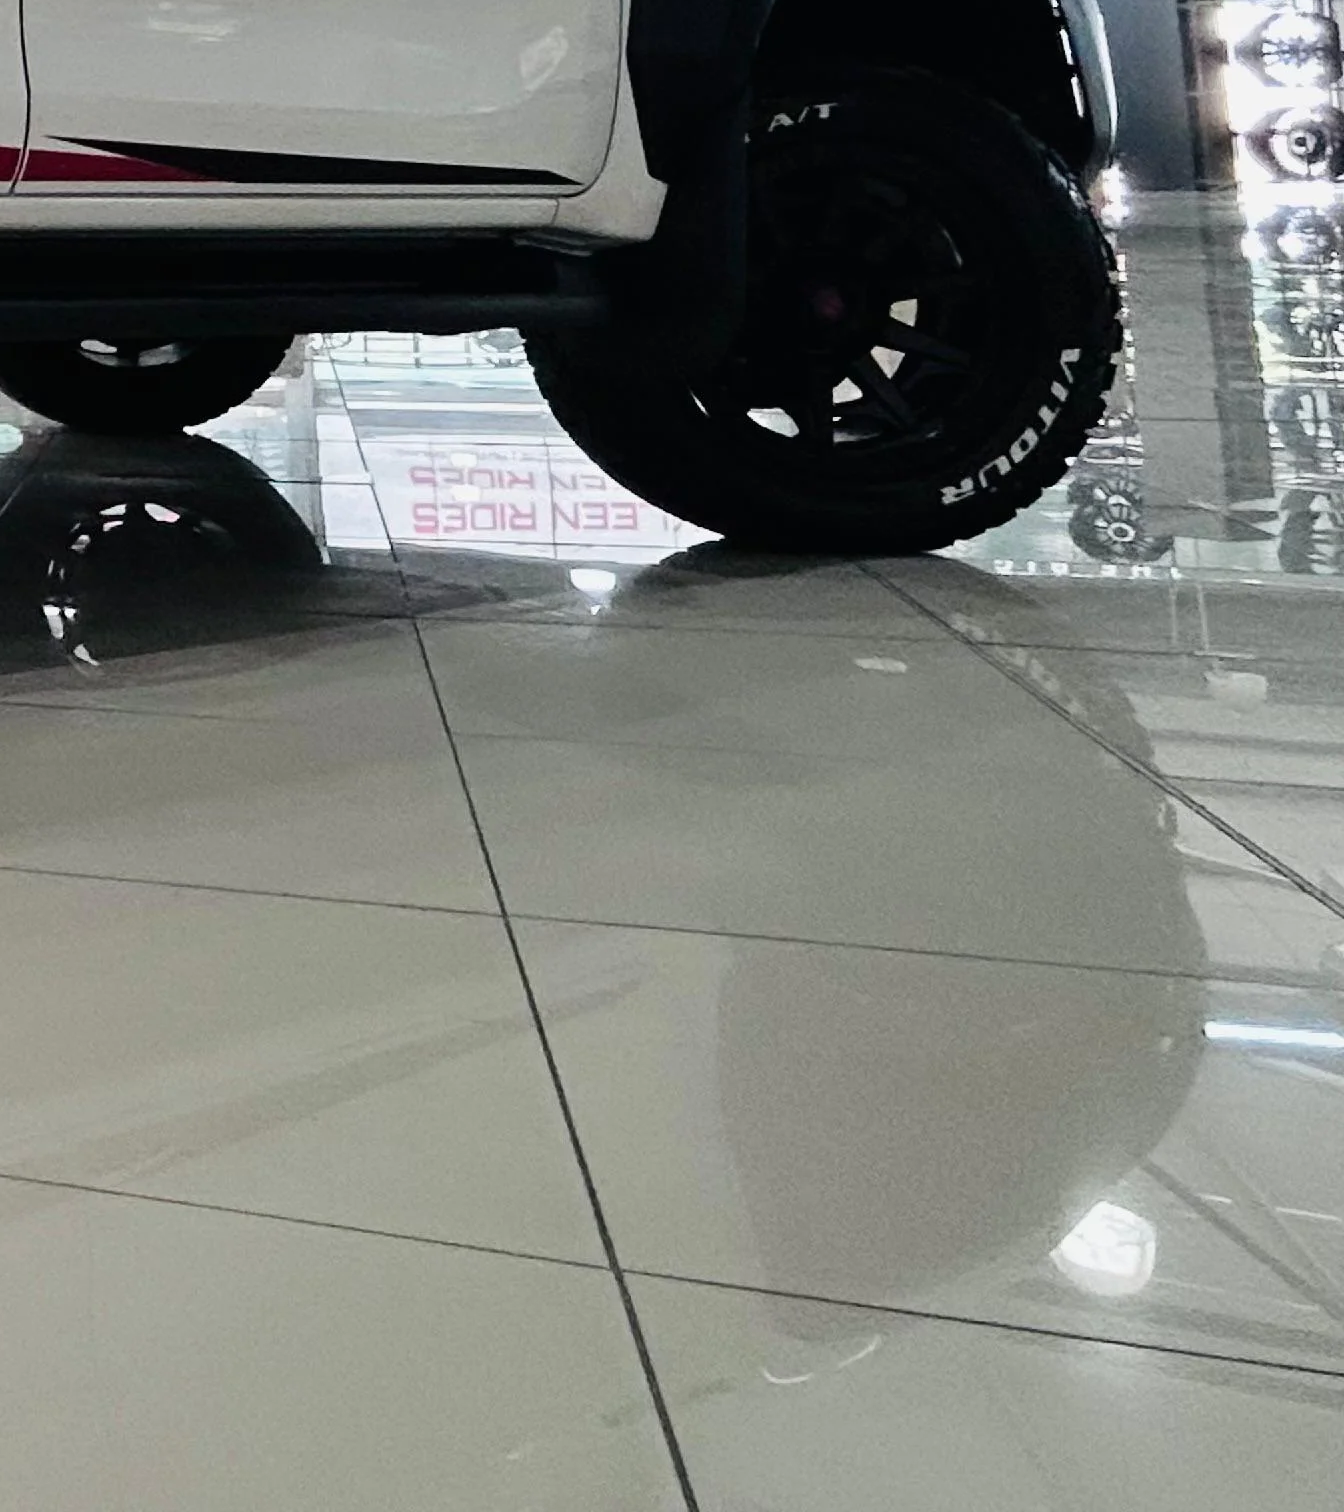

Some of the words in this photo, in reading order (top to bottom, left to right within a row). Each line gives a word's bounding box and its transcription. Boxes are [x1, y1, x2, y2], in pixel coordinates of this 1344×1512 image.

[768, 102, 839, 132] A/T
[939, 347, 1082, 507] VITOUR
[412, 501, 537, 534] RIDES
